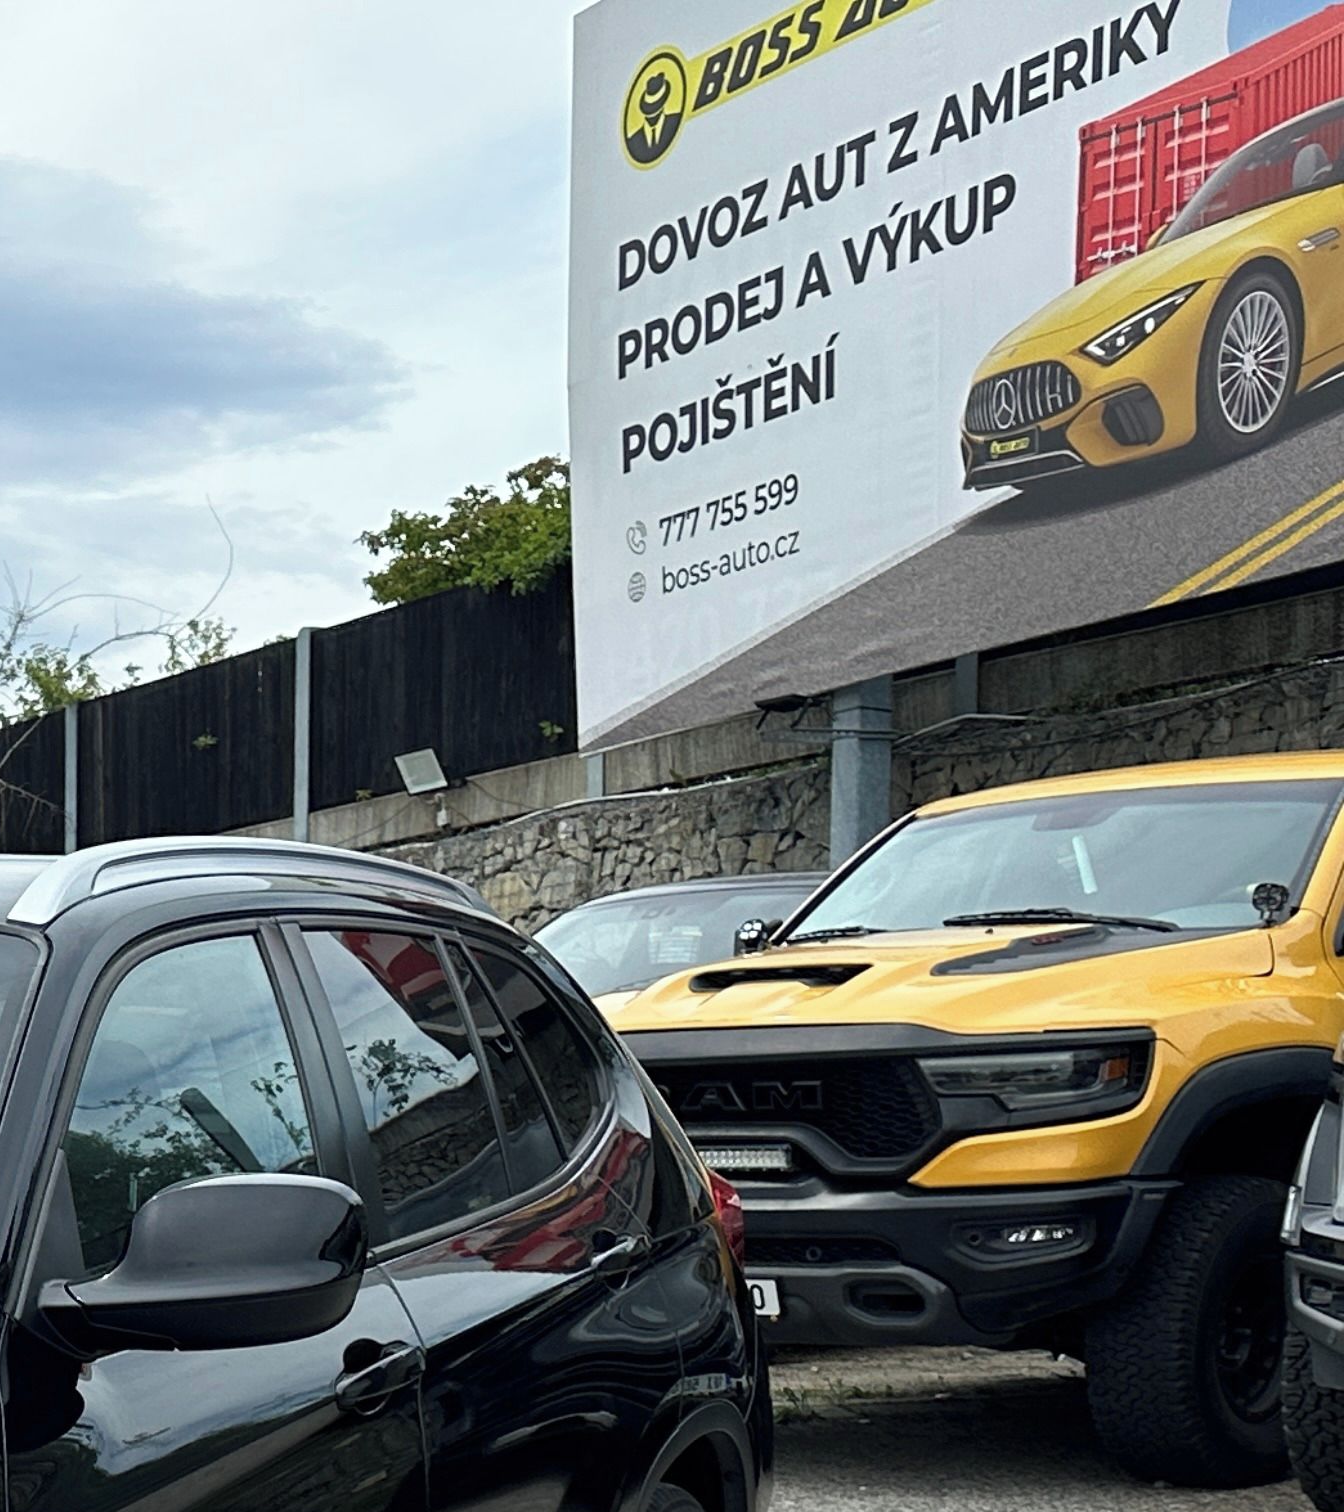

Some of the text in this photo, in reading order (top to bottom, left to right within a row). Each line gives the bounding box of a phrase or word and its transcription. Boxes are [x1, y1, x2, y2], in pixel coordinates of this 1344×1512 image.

[692, 0, 824, 112] BOSS
[618, 0, 1181, 292] DOVOZ AUT Z AMERIKY
[618, 173, 1017, 380] PRODEJ A VÝKUP
[622, 331, 840, 474] POJIŠTĚNÍ
[658, 473, 799, 547] 777 755 599
[662, 530, 801, 594] boss-auto.cz
[658, 1080, 822, 1111] AM
